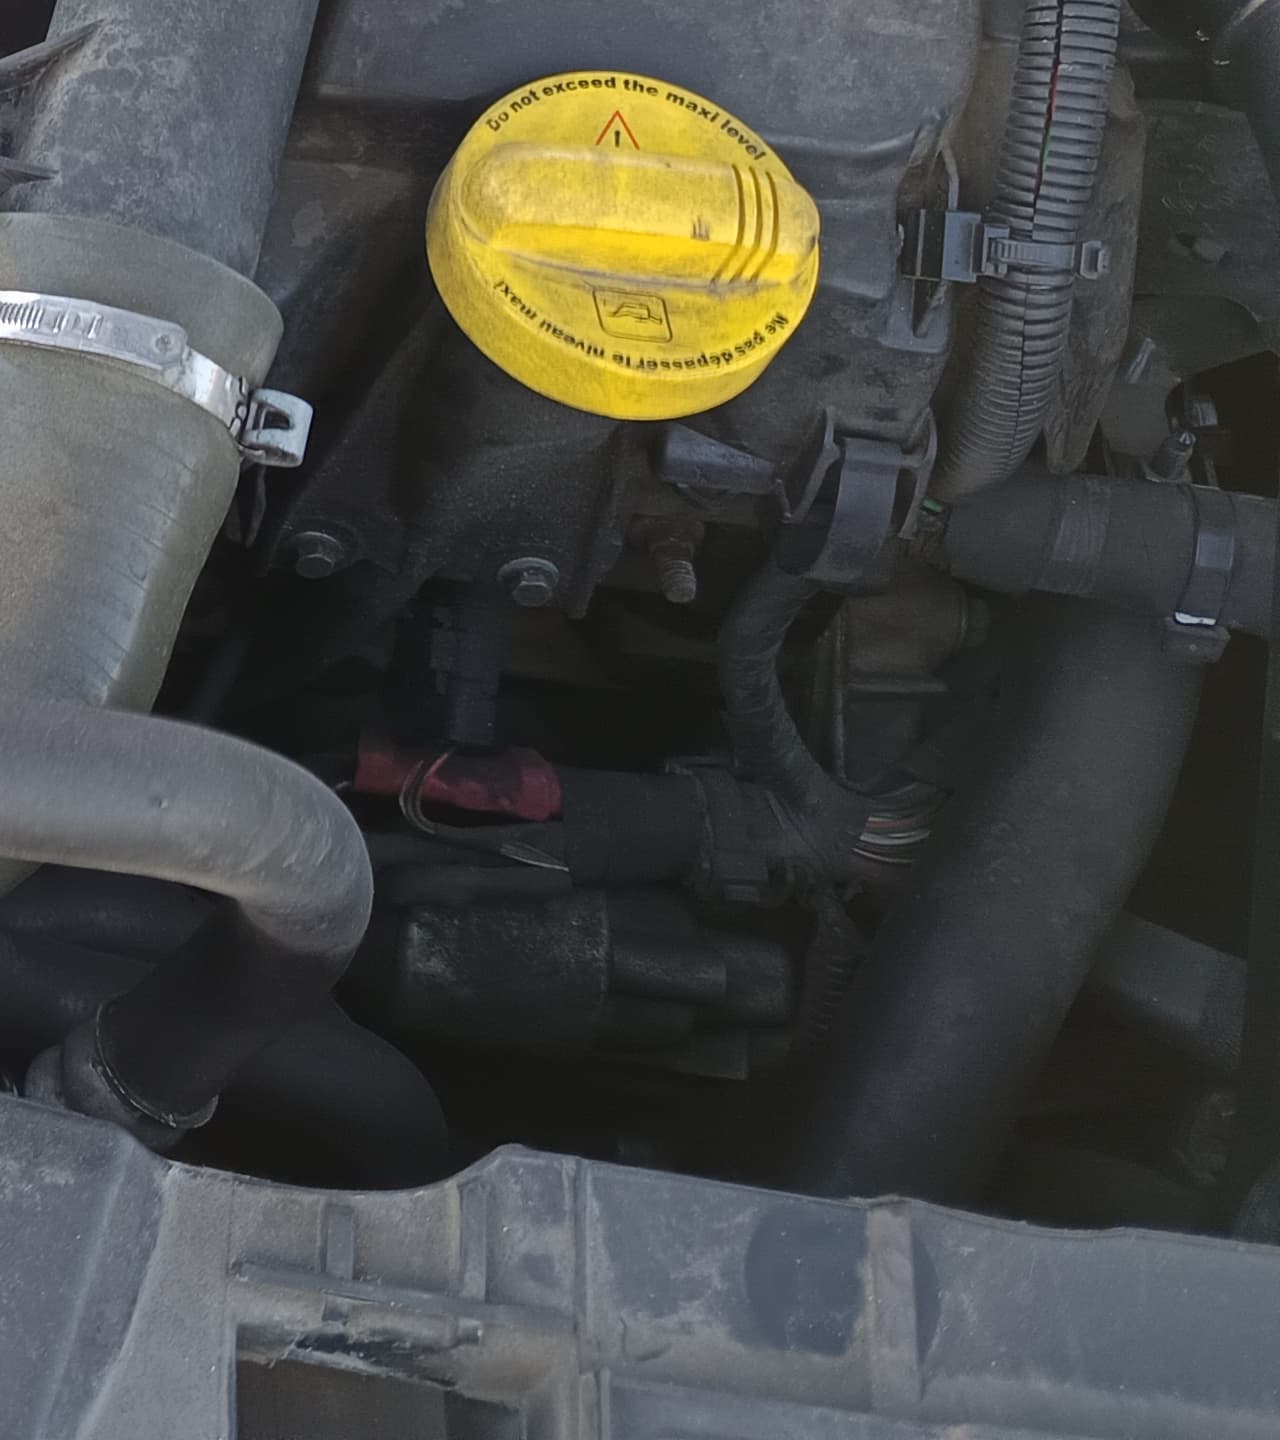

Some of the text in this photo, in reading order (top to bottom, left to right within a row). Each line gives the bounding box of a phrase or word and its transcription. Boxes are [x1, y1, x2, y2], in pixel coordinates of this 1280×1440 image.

[485, 76, 768, 161] Do not exceed the maxi level
[492, 280, 539, 321] maxi
[539, 320, 605, 359] niveau
[765, 311, 790, 336] Ne
[612, 352, 631, 368] le
[733, 331, 767, 358] pas
